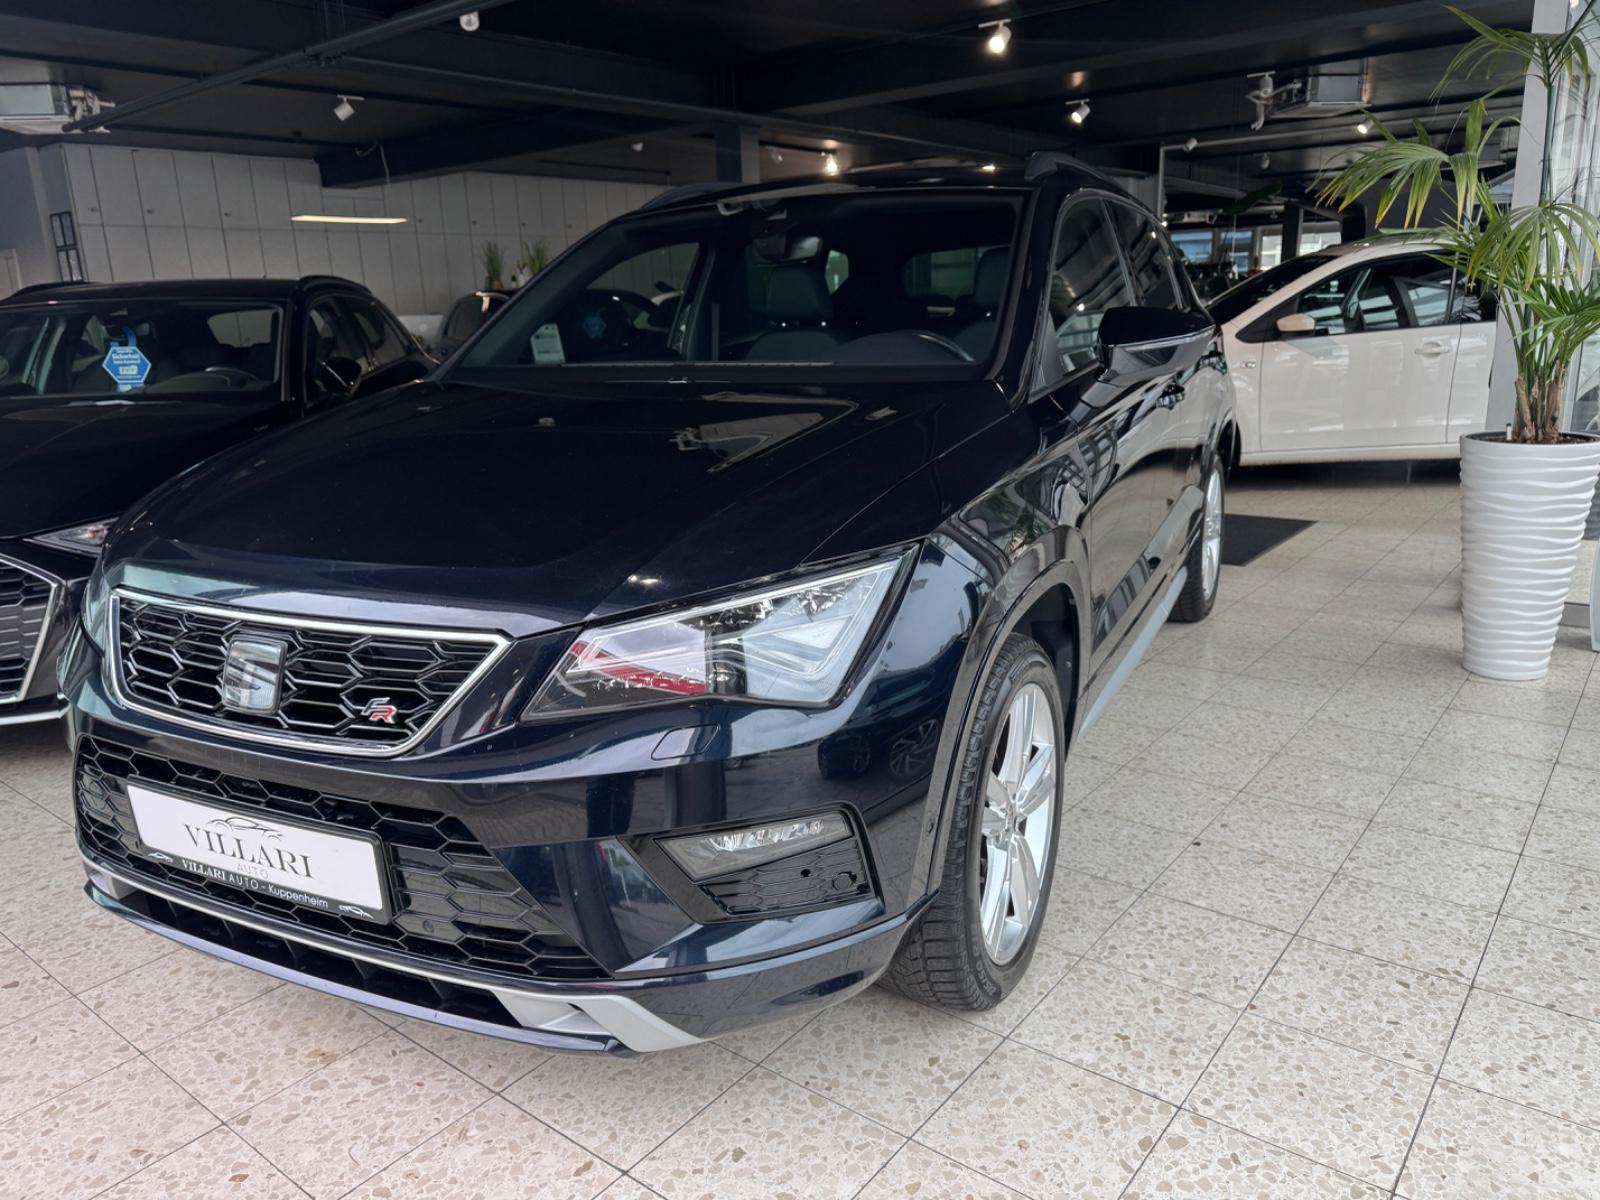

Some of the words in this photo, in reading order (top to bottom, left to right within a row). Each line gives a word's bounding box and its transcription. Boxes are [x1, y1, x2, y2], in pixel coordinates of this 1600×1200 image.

[184, 823, 315, 879] VILLARI
[236, 863, 269, 880] AUTO
[181, 859, 226, 881] VILLARI
[228, 873, 259, 890] AUTO
[268, 883, 328, 908] Kuppenheim
